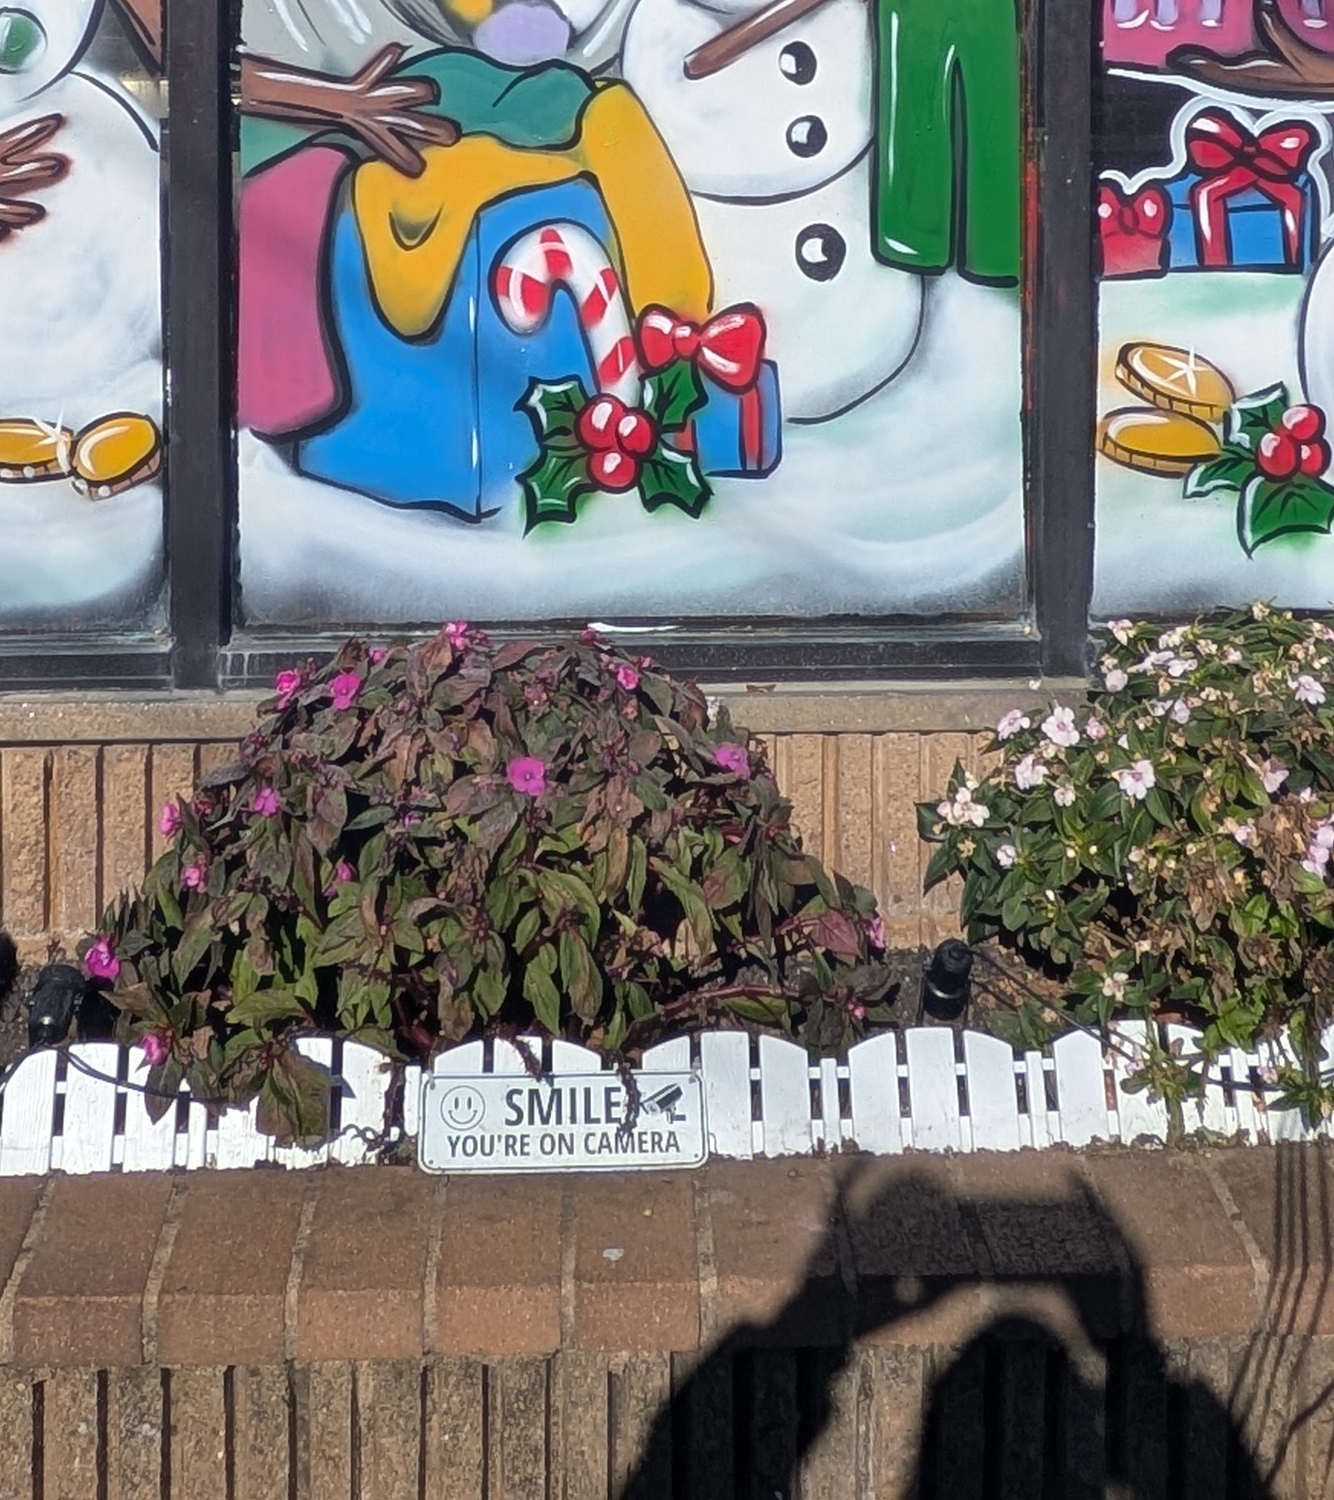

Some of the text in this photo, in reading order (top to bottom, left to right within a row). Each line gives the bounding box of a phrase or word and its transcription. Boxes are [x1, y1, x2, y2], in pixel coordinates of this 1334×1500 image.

[504, 1086, 622, 1126] SMILE
[447, 1130, 680, 1158] YOU'RE ON CAMERA
